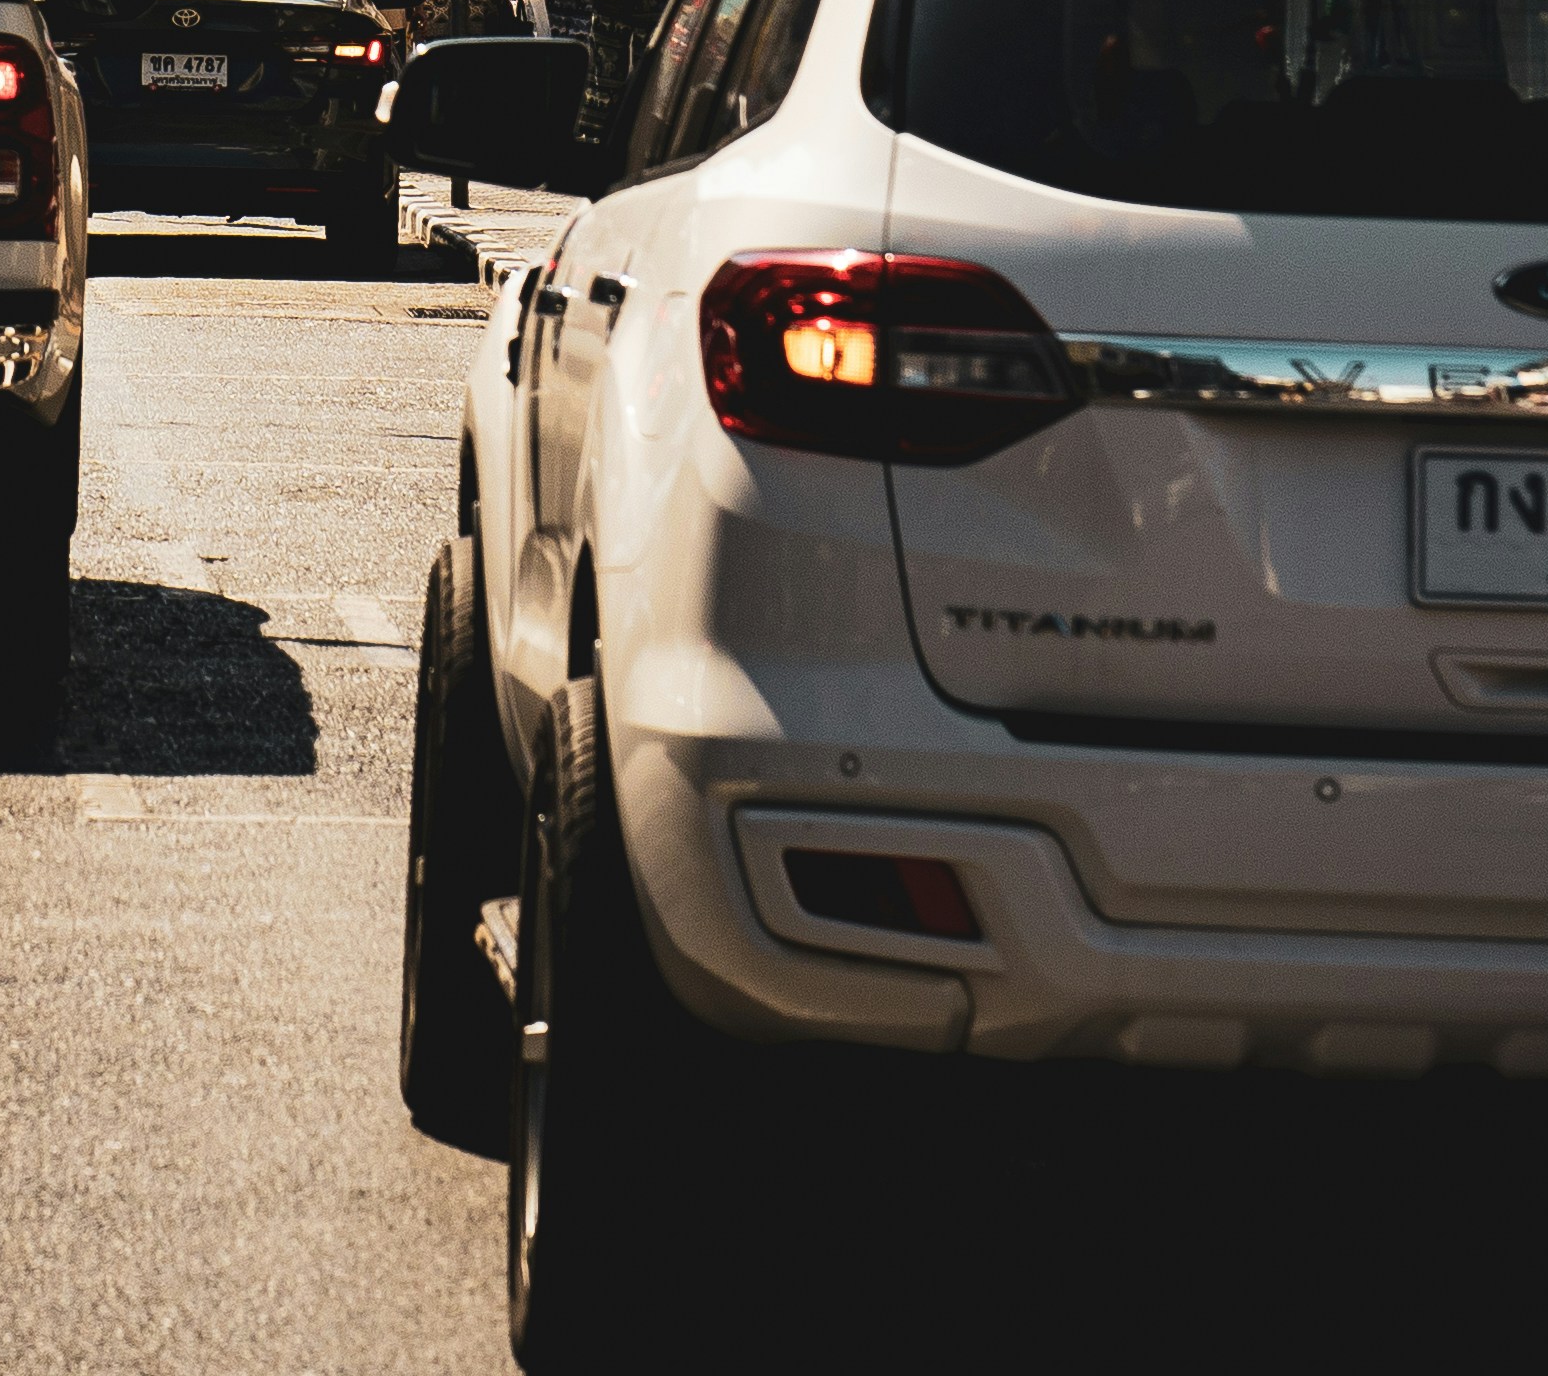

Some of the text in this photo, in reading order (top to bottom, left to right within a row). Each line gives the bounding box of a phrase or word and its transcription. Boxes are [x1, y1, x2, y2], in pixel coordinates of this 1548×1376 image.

[183, 56, 226, 74] 4787
[1457, 469, 1546, 534] กง
[945, 605, 1216, 640] TITANIUM
